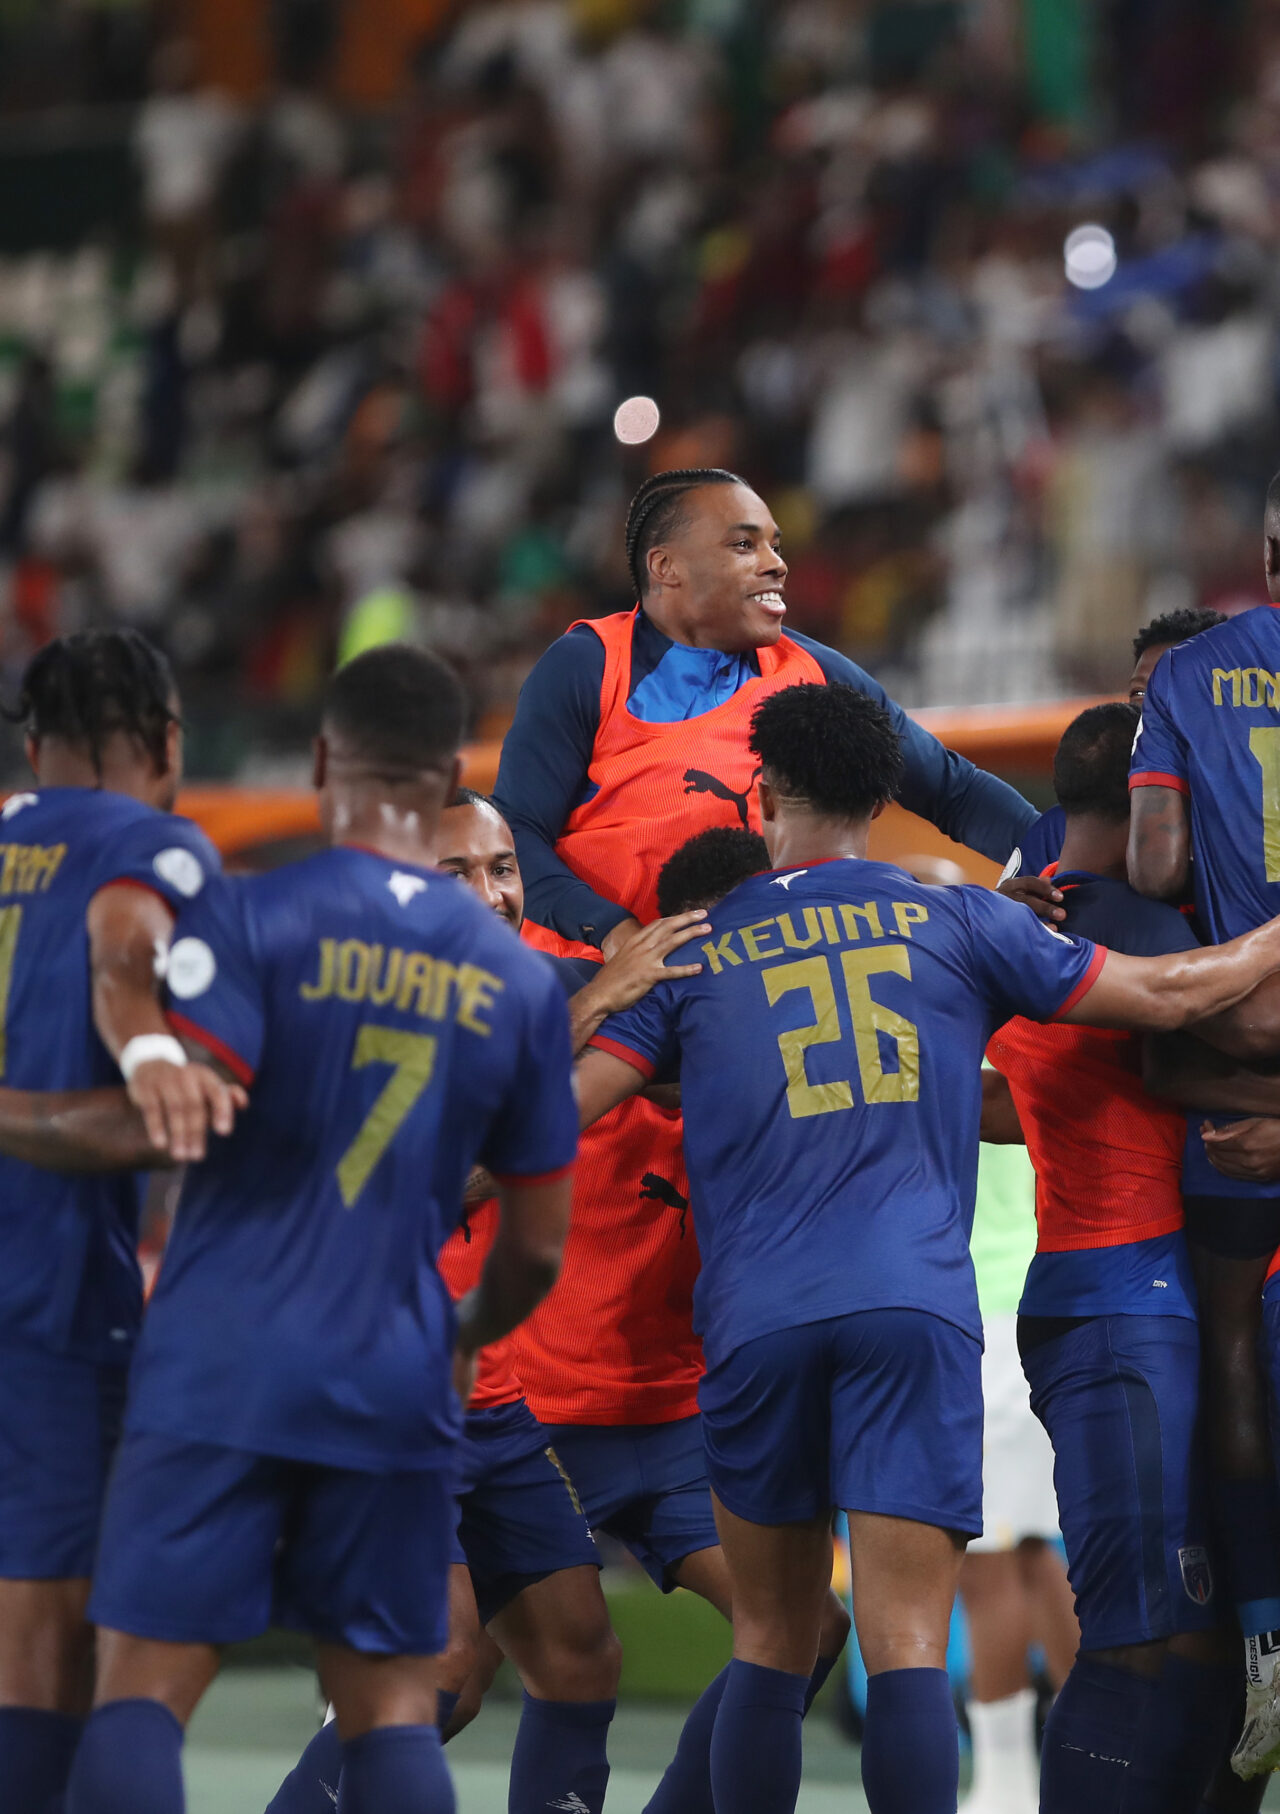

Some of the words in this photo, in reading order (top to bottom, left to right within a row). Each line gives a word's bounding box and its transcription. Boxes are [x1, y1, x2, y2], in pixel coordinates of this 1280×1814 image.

[701, 901, 929, 975] KEVIN.P
[335, 1023, 438, 1210] 7
[761, 944, 920, 1119] 26
